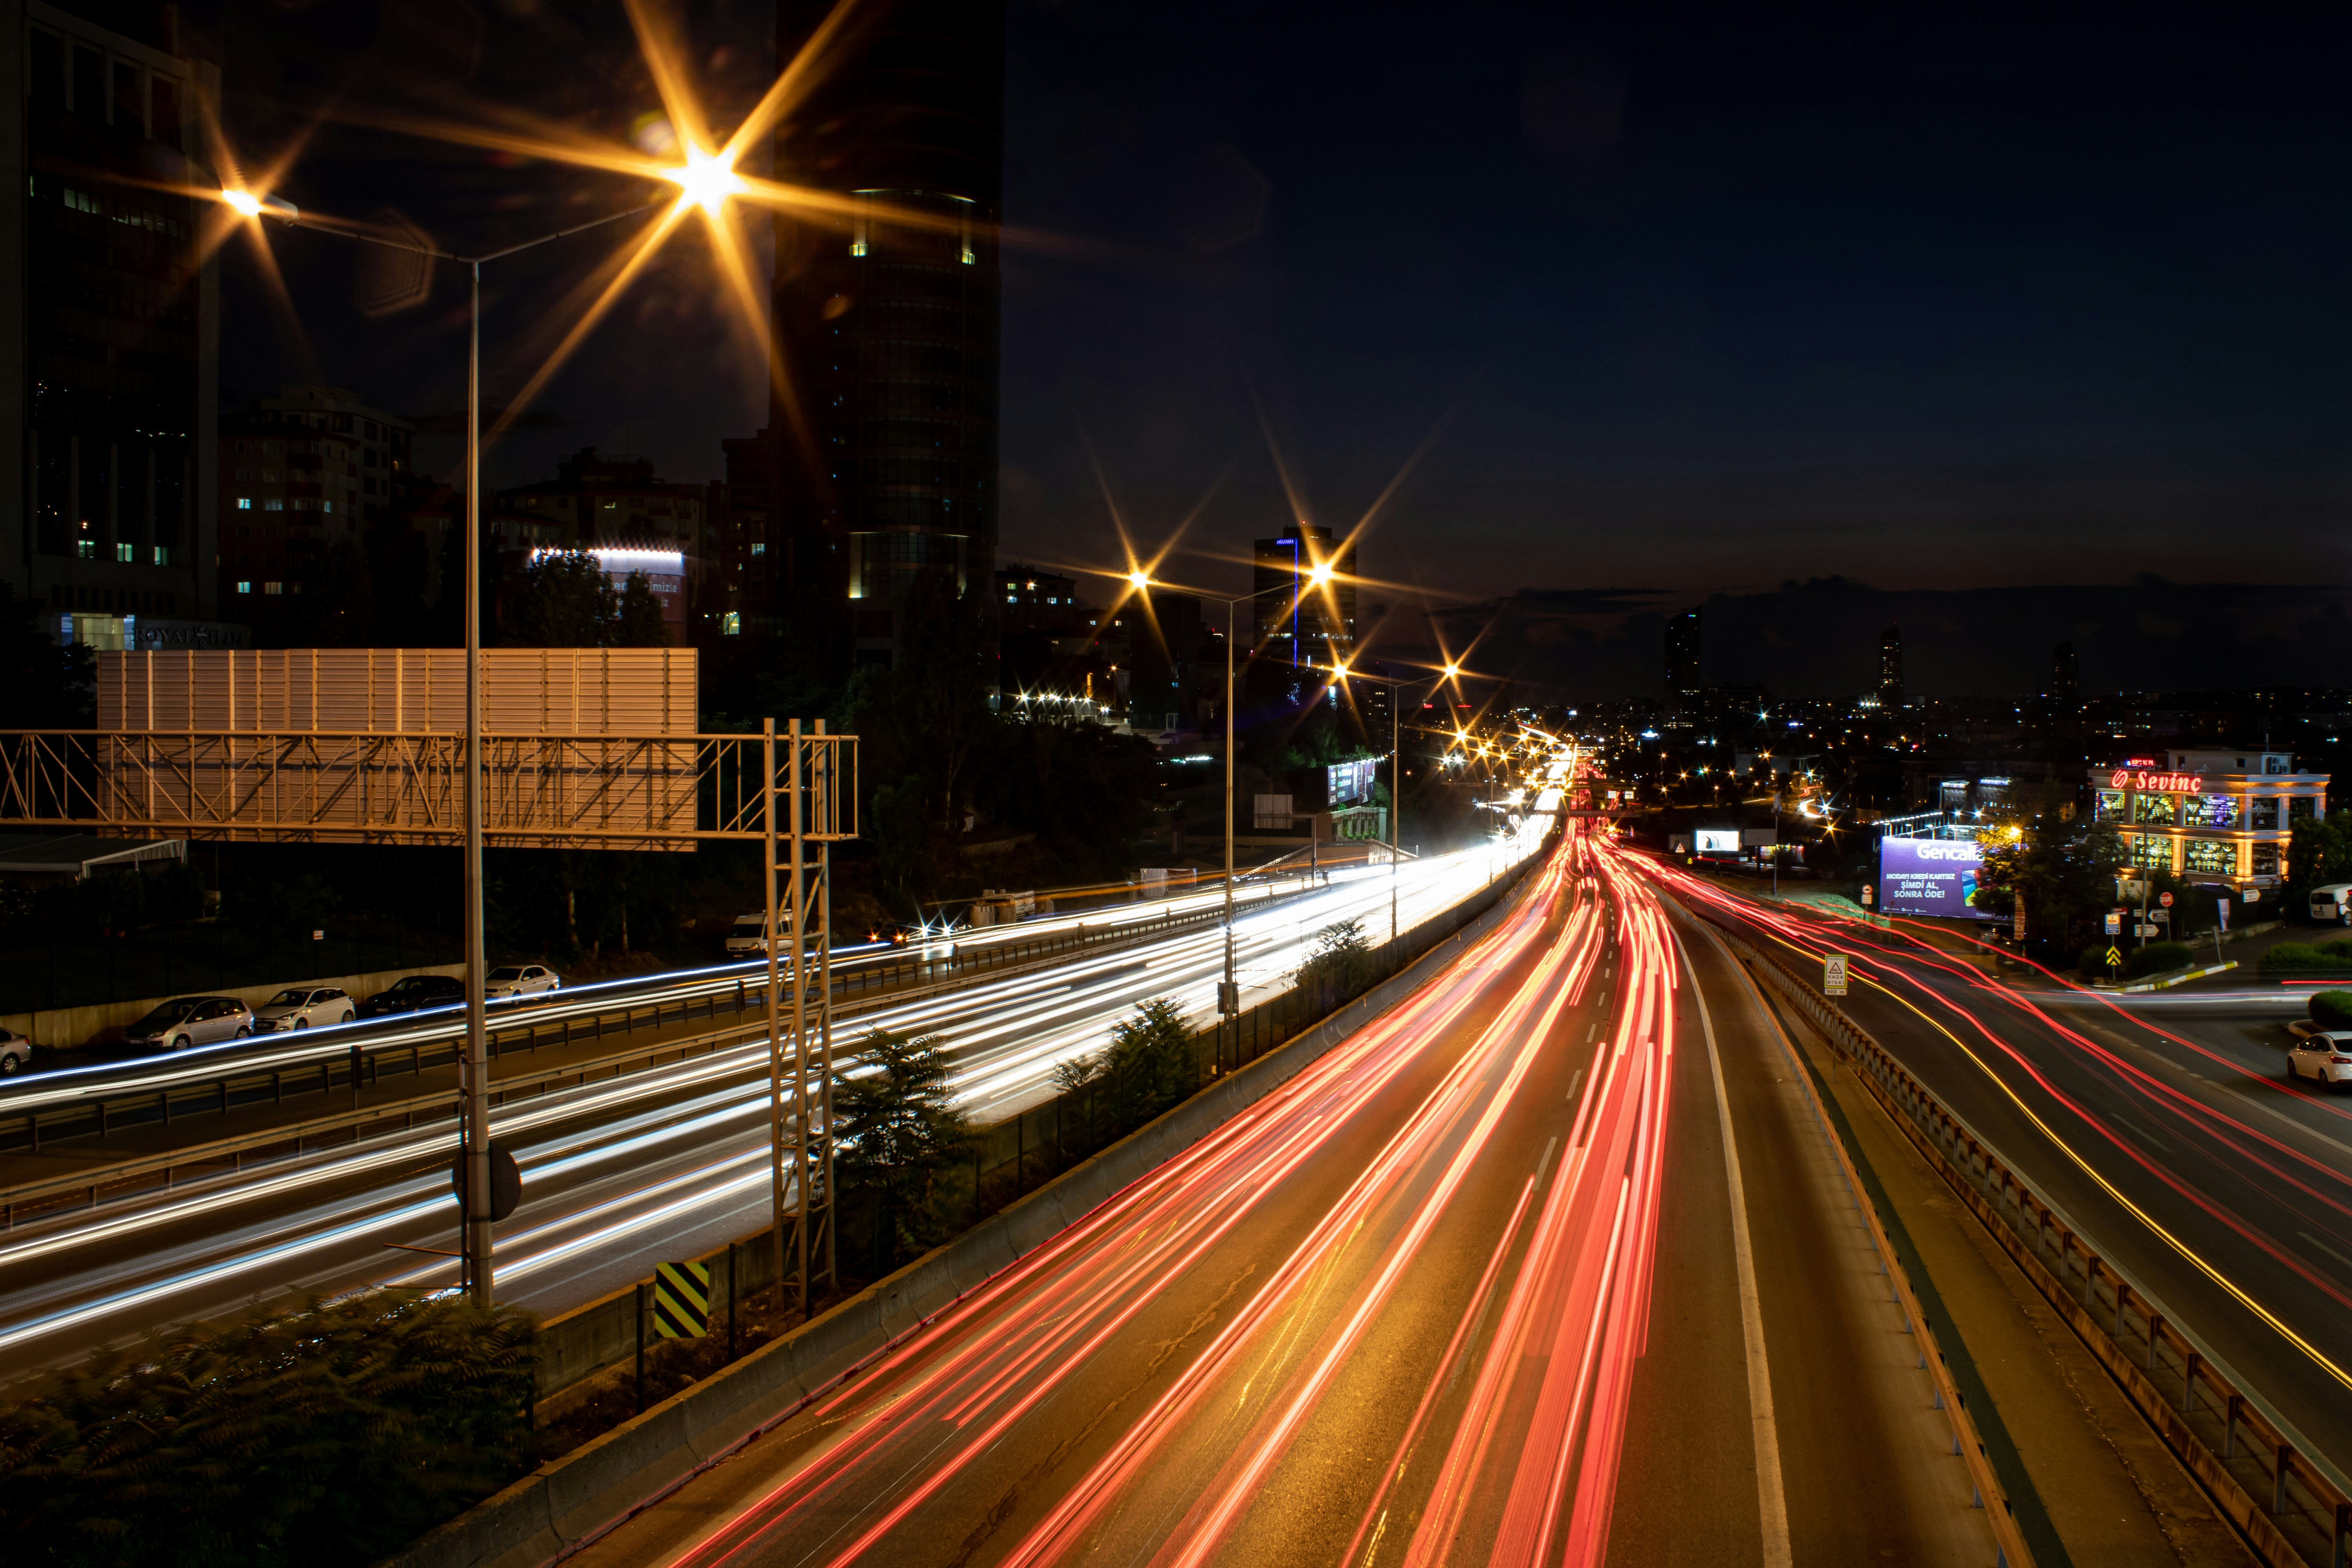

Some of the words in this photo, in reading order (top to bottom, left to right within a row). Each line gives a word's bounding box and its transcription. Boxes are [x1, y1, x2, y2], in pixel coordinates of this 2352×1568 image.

[135, 628, 194, 643] ROYAL
[210, 631, 243, 645] PLAZA
[199, 639, 206, 649] R
[2136, 771, 2201, 795] Sevinç
[1900, 880, 1924, 891] ŞİMDİ
[1926, 881, 1939, 890] AL,
[1924, 889, 1945, 898] ÖDE!
